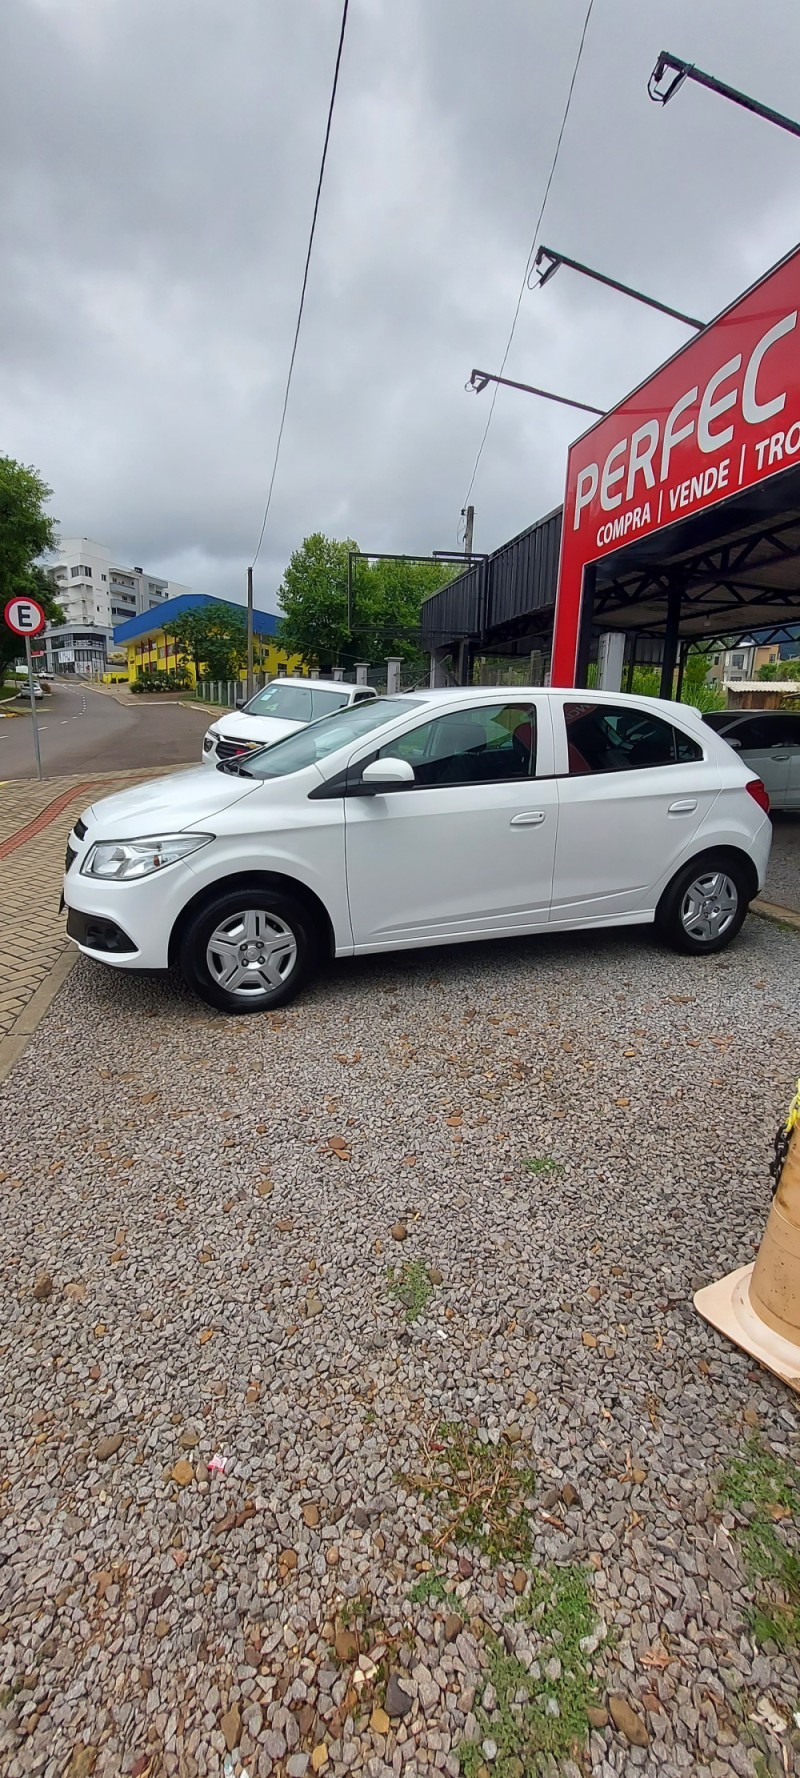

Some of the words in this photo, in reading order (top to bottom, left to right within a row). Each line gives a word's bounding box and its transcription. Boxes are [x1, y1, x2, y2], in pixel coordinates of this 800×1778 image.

[573, 310, 798, 530] PERFEC
[596, 503, 651, 547] COMPRA
[669, 458, 730, 512] VENDE
[17, 605, 33, 627] E
